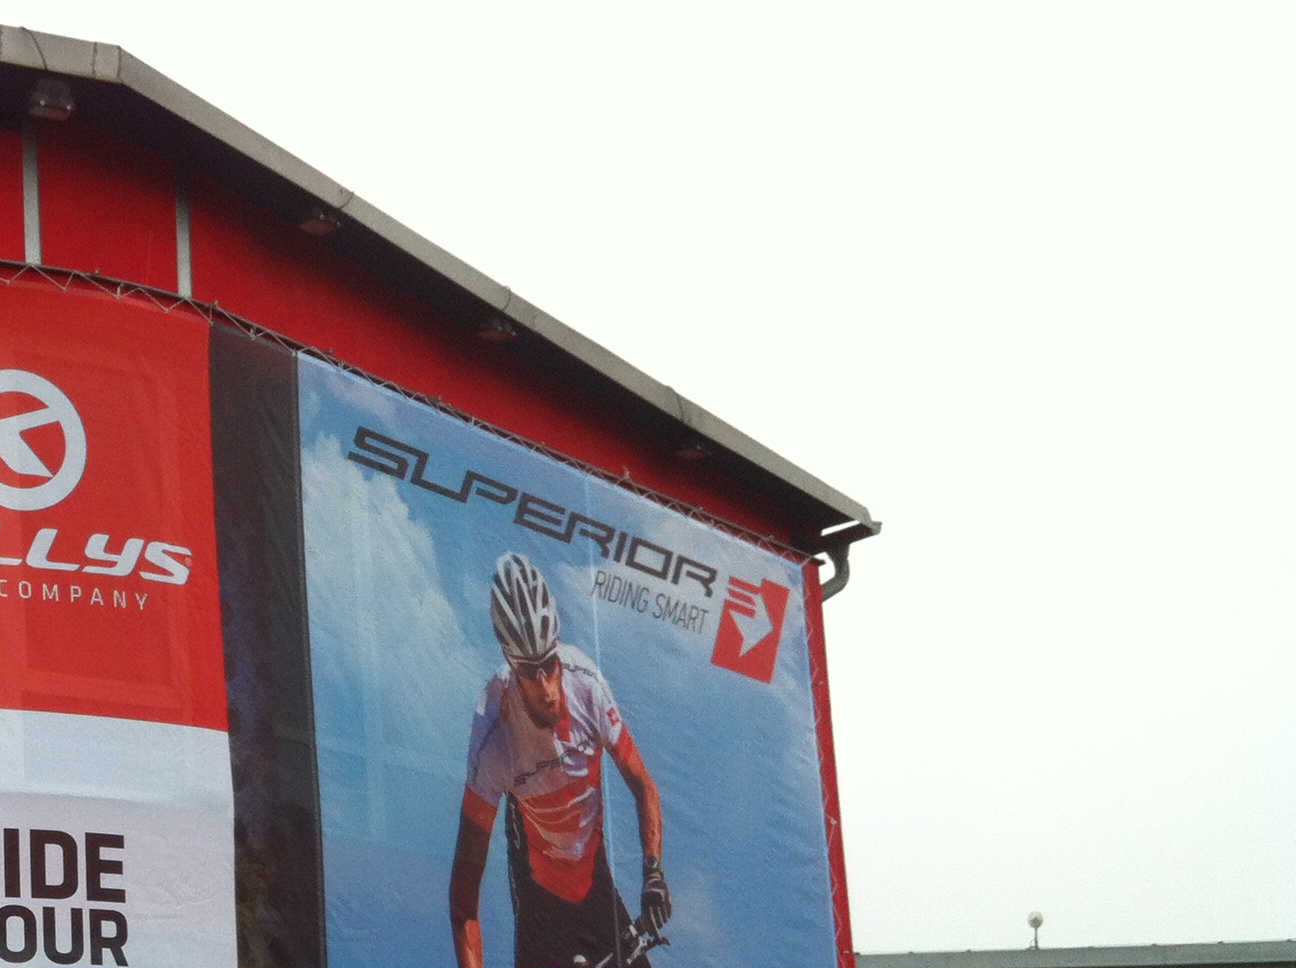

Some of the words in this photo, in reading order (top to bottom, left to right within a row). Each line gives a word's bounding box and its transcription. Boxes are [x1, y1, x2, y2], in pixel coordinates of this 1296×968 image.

[348, 425, 718, 599] SUPERIOR
[591, 569, 650, 614] RIDING
[651, 592, 710, 635] SMART
